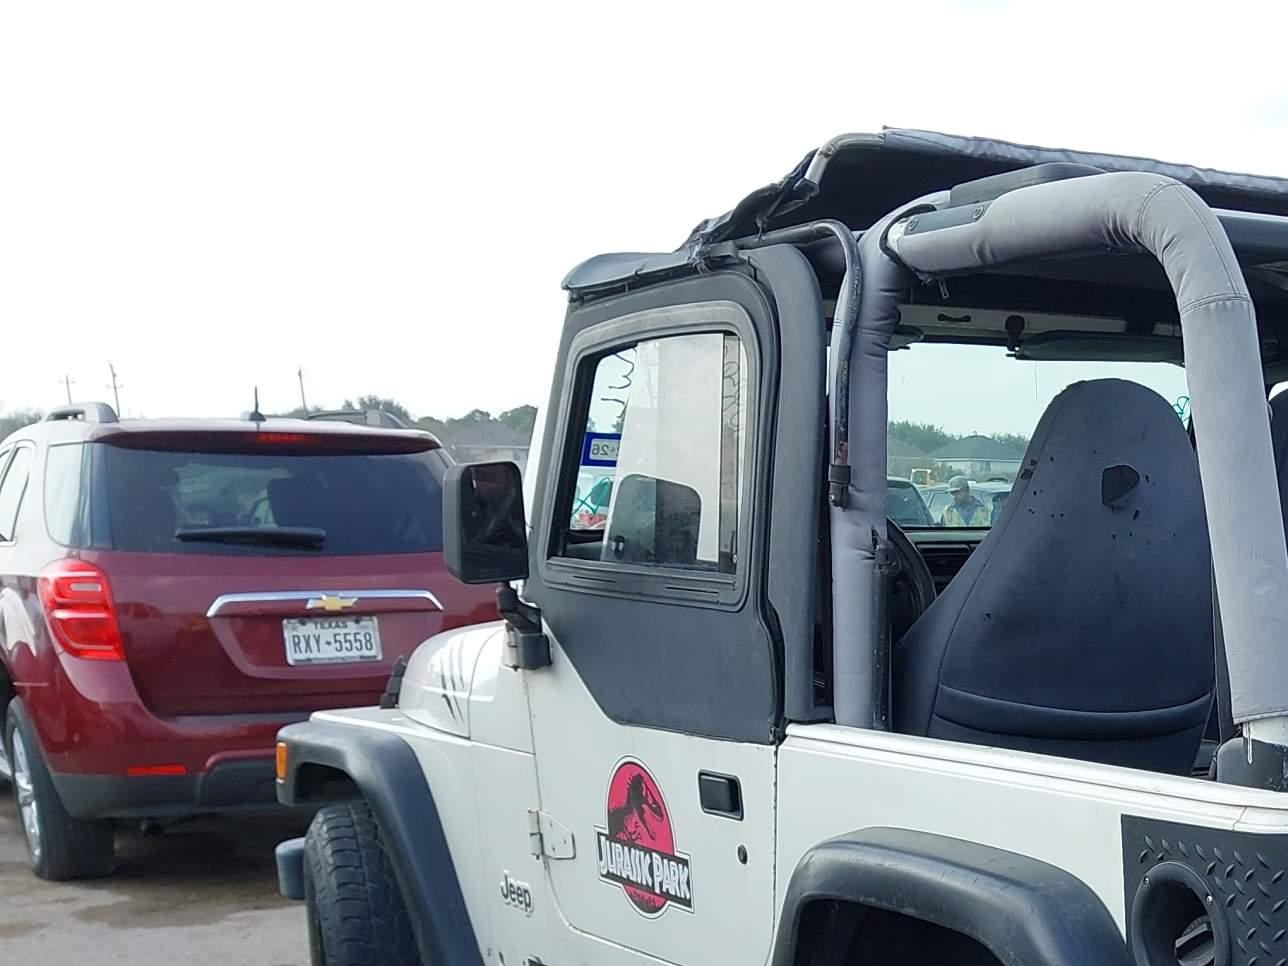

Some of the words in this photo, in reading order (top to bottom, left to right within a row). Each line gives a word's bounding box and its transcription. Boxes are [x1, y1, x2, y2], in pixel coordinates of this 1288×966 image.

[313, 620, 348, 630] TEXAS
[499, 870, 533, 914] Jeep
[652, 852, 691, 900] PARK
